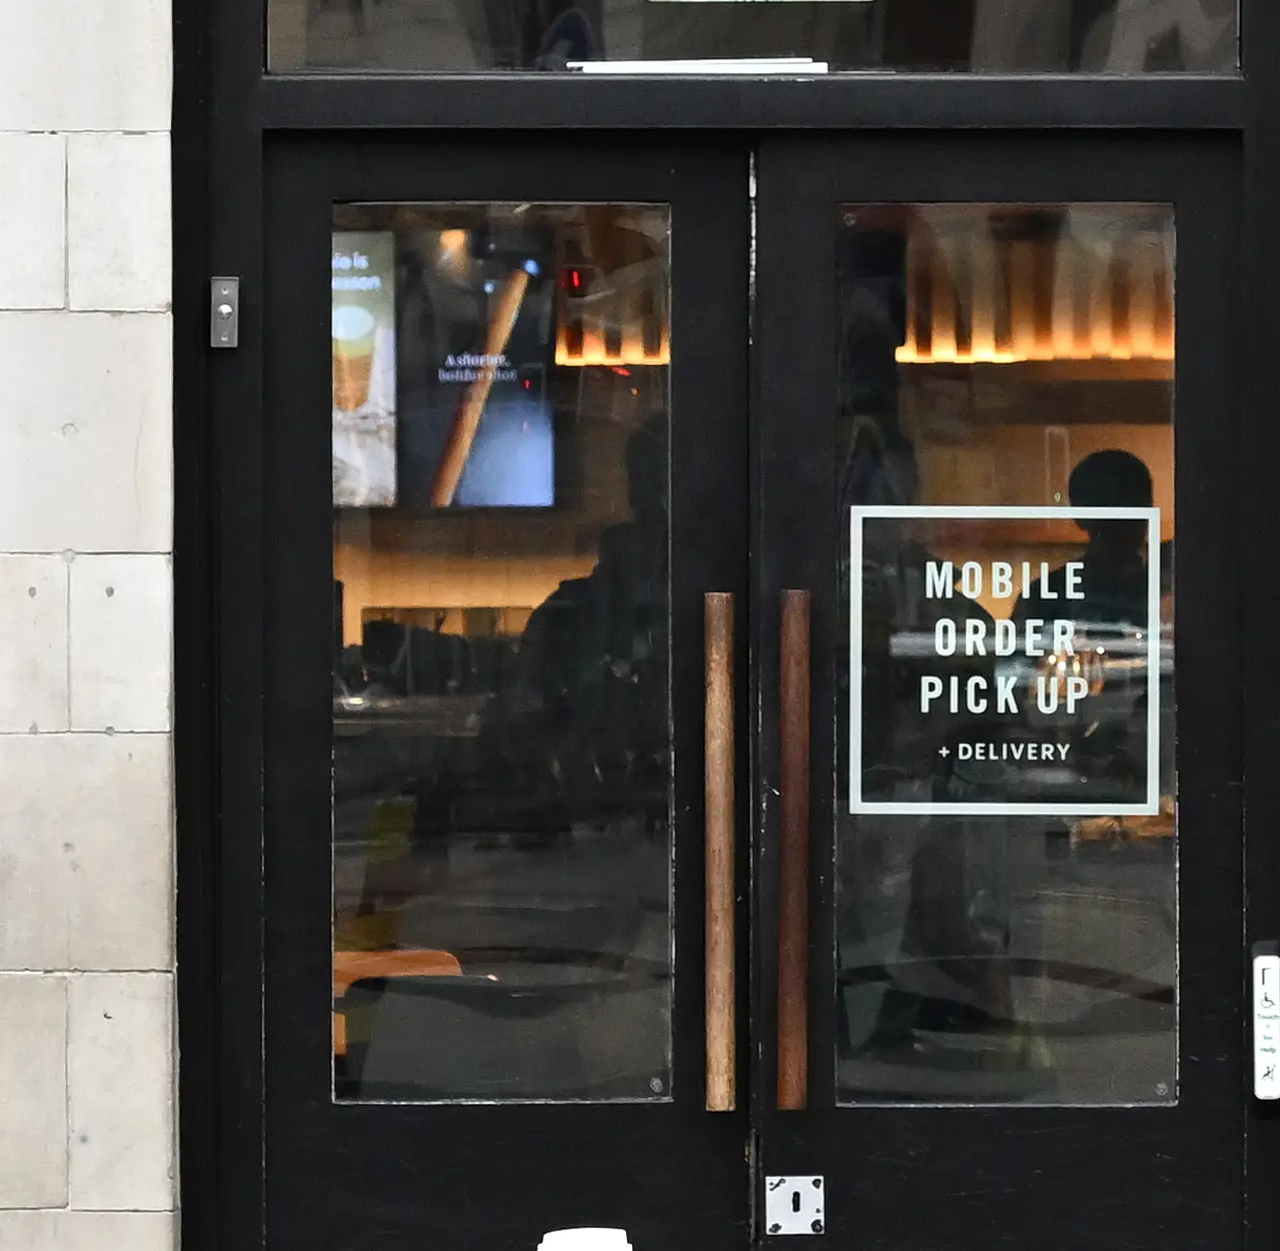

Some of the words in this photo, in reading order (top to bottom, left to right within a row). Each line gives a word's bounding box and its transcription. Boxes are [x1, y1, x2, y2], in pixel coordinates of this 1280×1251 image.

[925, 561, 1086, 600] MOBILE
[935, 617, 1076, 657] ORDER
[920, 675, 1019, 714] PICK
[1036, 675, 1089, 715] UP
[958, 743, 1071, 761] DELIVERY
